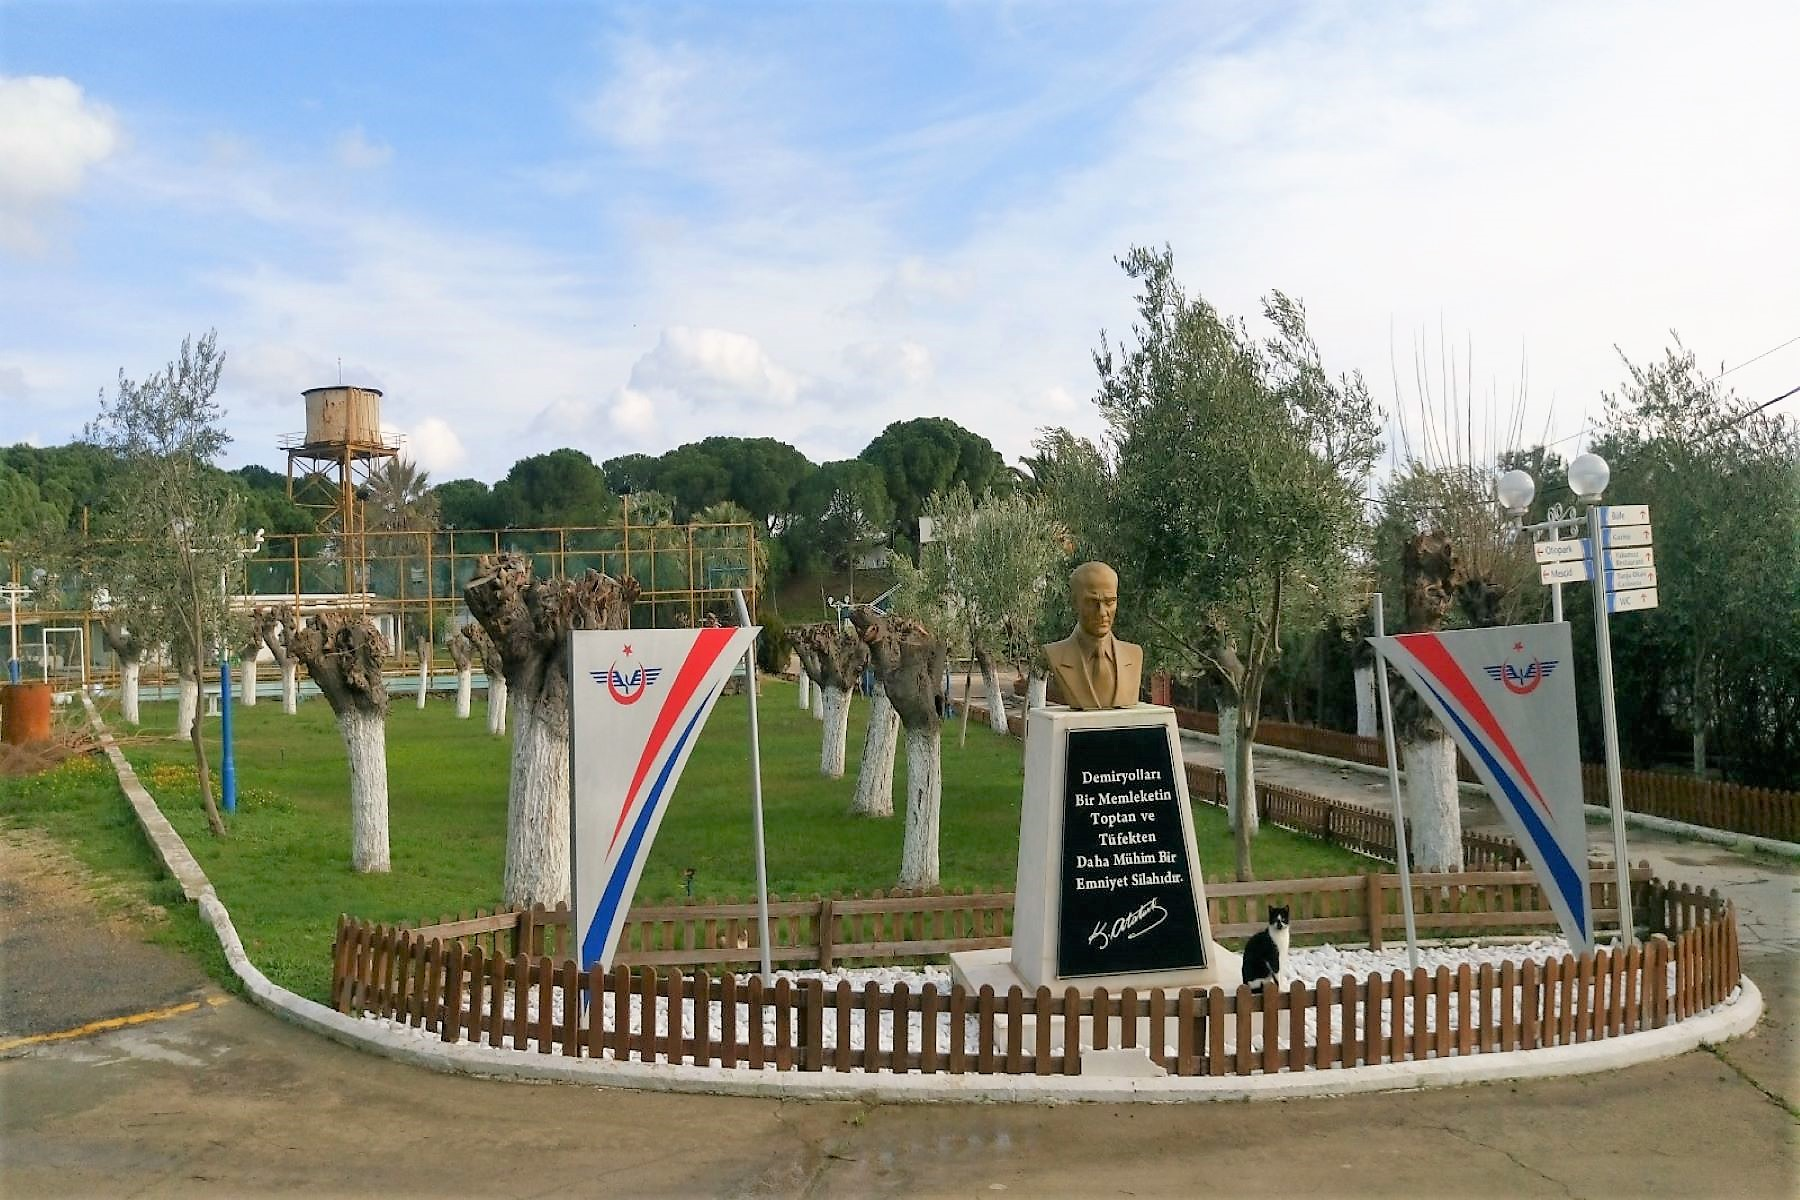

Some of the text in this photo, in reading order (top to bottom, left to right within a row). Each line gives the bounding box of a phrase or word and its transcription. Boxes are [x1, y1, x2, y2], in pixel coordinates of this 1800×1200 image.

[1545, 545, 1571, 556] Otopark
[1619, 596, 1632, 607] WC
[1081, 769, 1162, 785] Demiryolları
[1075, 788, 1172, 807] Bir Memleketin
[1090, 810, 1155, 827] Toptan ve
[1098, 831, 1157, 846] Tüfekten
[1076, 850, 1177, 868] Daha Mühim Bir
[1075, 871, 1184, 891] Emniyet Silahıdır.
